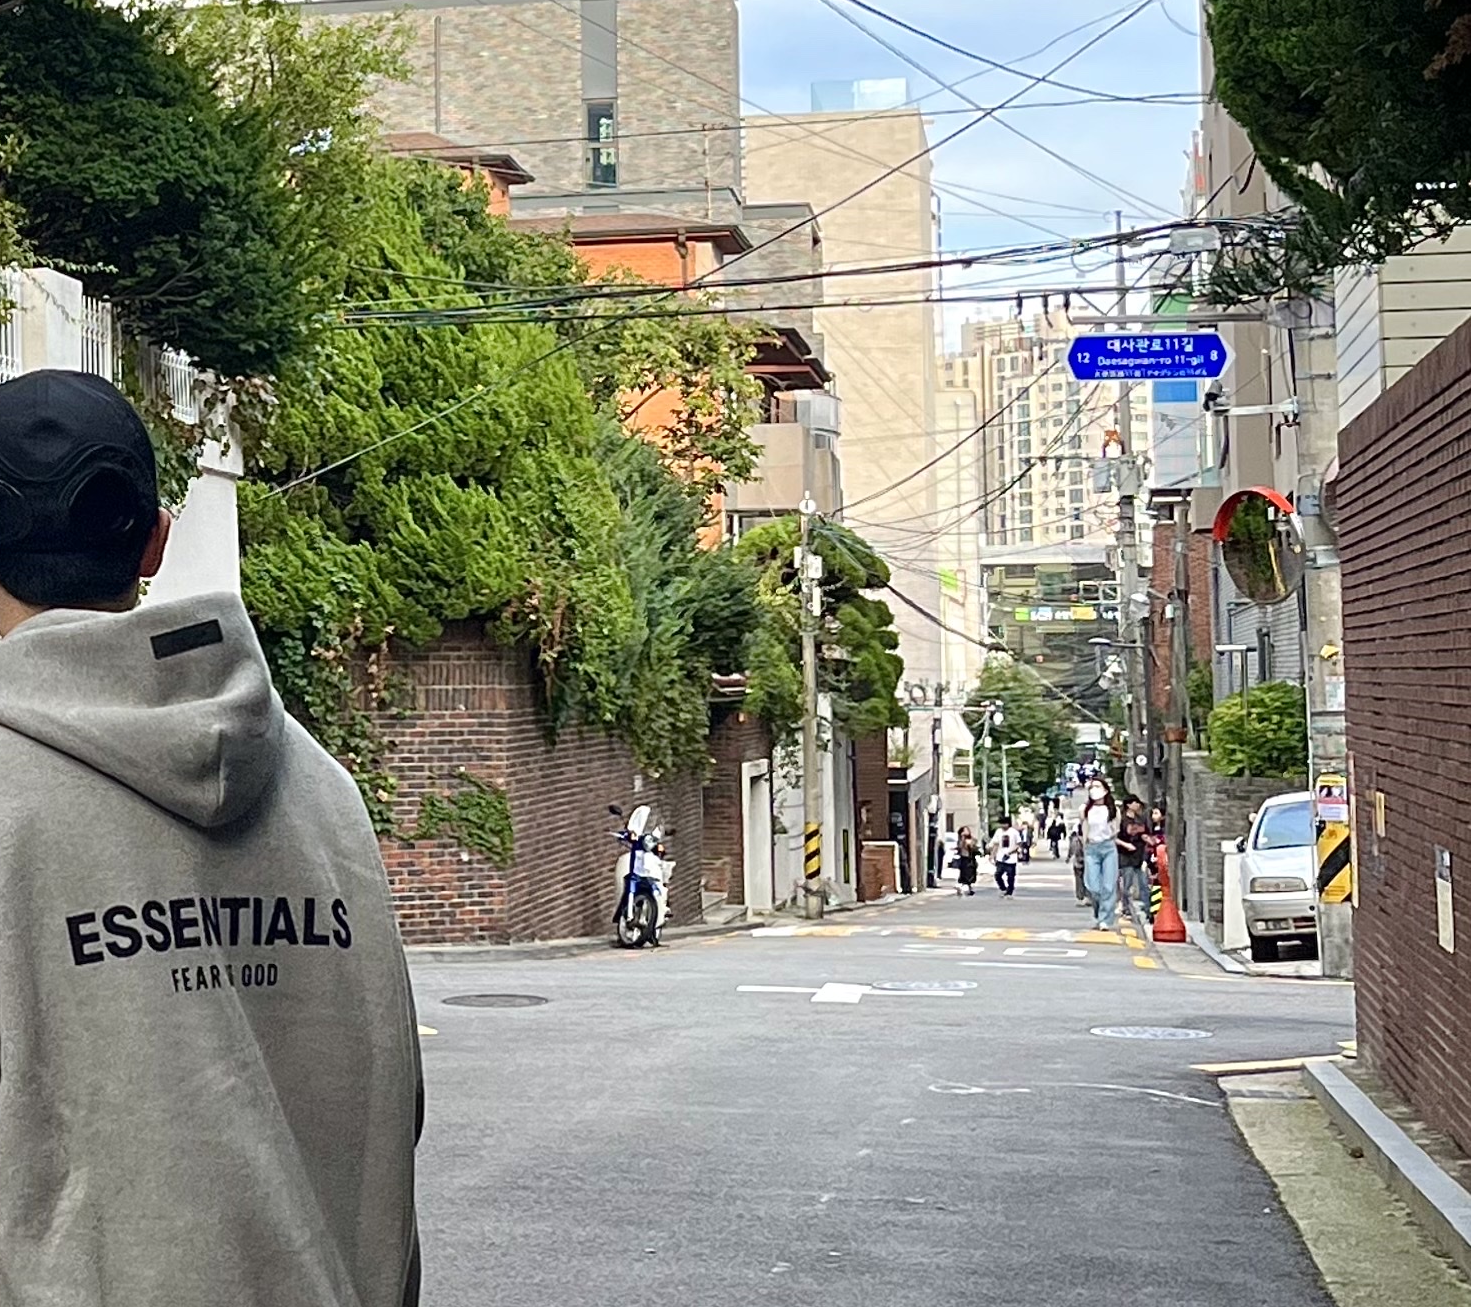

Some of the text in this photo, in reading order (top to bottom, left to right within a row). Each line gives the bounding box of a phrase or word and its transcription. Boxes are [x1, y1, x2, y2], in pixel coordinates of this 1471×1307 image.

[1107, 338, 1193, 352] 대사관로11길
[1076, 352, 1090, 363] 12
[1210, 350, 1218, 361] 8
[65, 896, 352, 966] ESSENTIALS
[171, 964, 221, 992] FEAR
[241, 963, 278, 987] GOD
